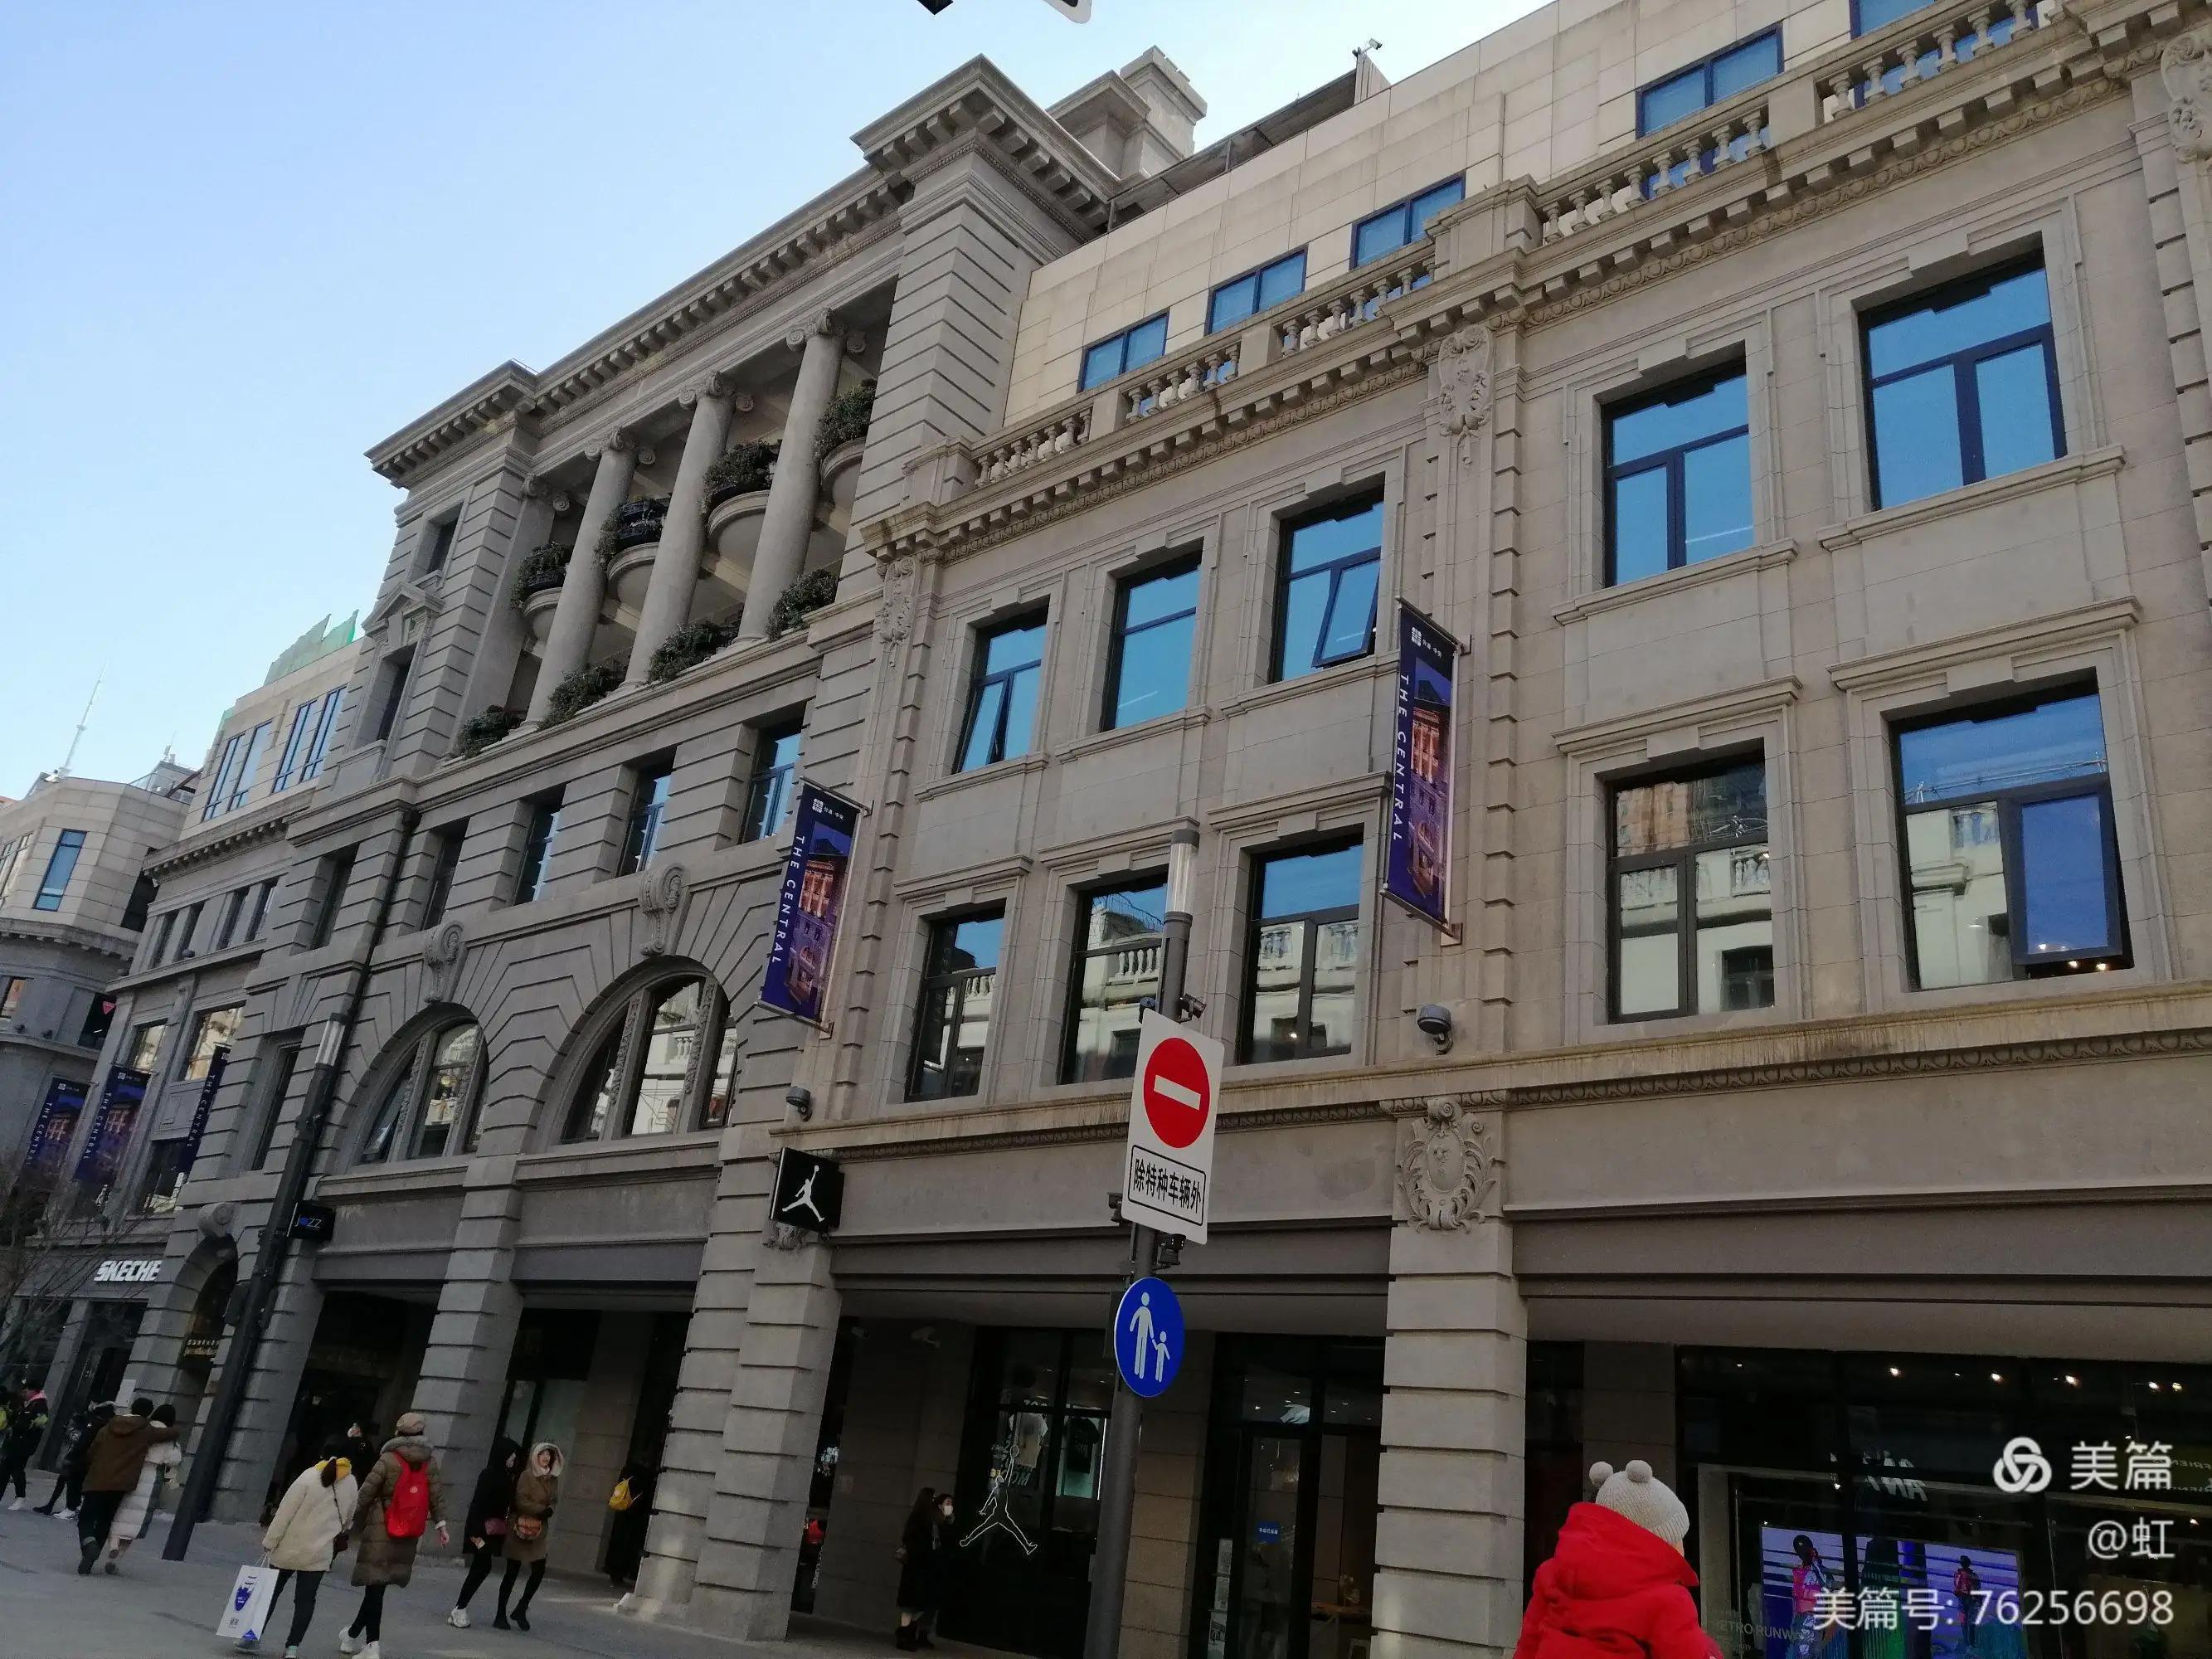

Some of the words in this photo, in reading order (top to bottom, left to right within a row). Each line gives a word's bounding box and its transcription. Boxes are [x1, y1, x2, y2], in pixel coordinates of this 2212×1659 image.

[1397, 673, 1409, 718] THE
[1393, 730, 1407, 840] CENTRAL
[790, 834, 805, 869] THE
[772, 878, 796, 964] CENTRAL
[99, 1092, 112, 1114] THE
[203, 1074, 216, 1097] THE
[40, 1102, 52, 1124] THE
[82, 1116, 104, 1160] CENTRAL
[1133, 1158, 1202, 1214] 除特种车辆外
